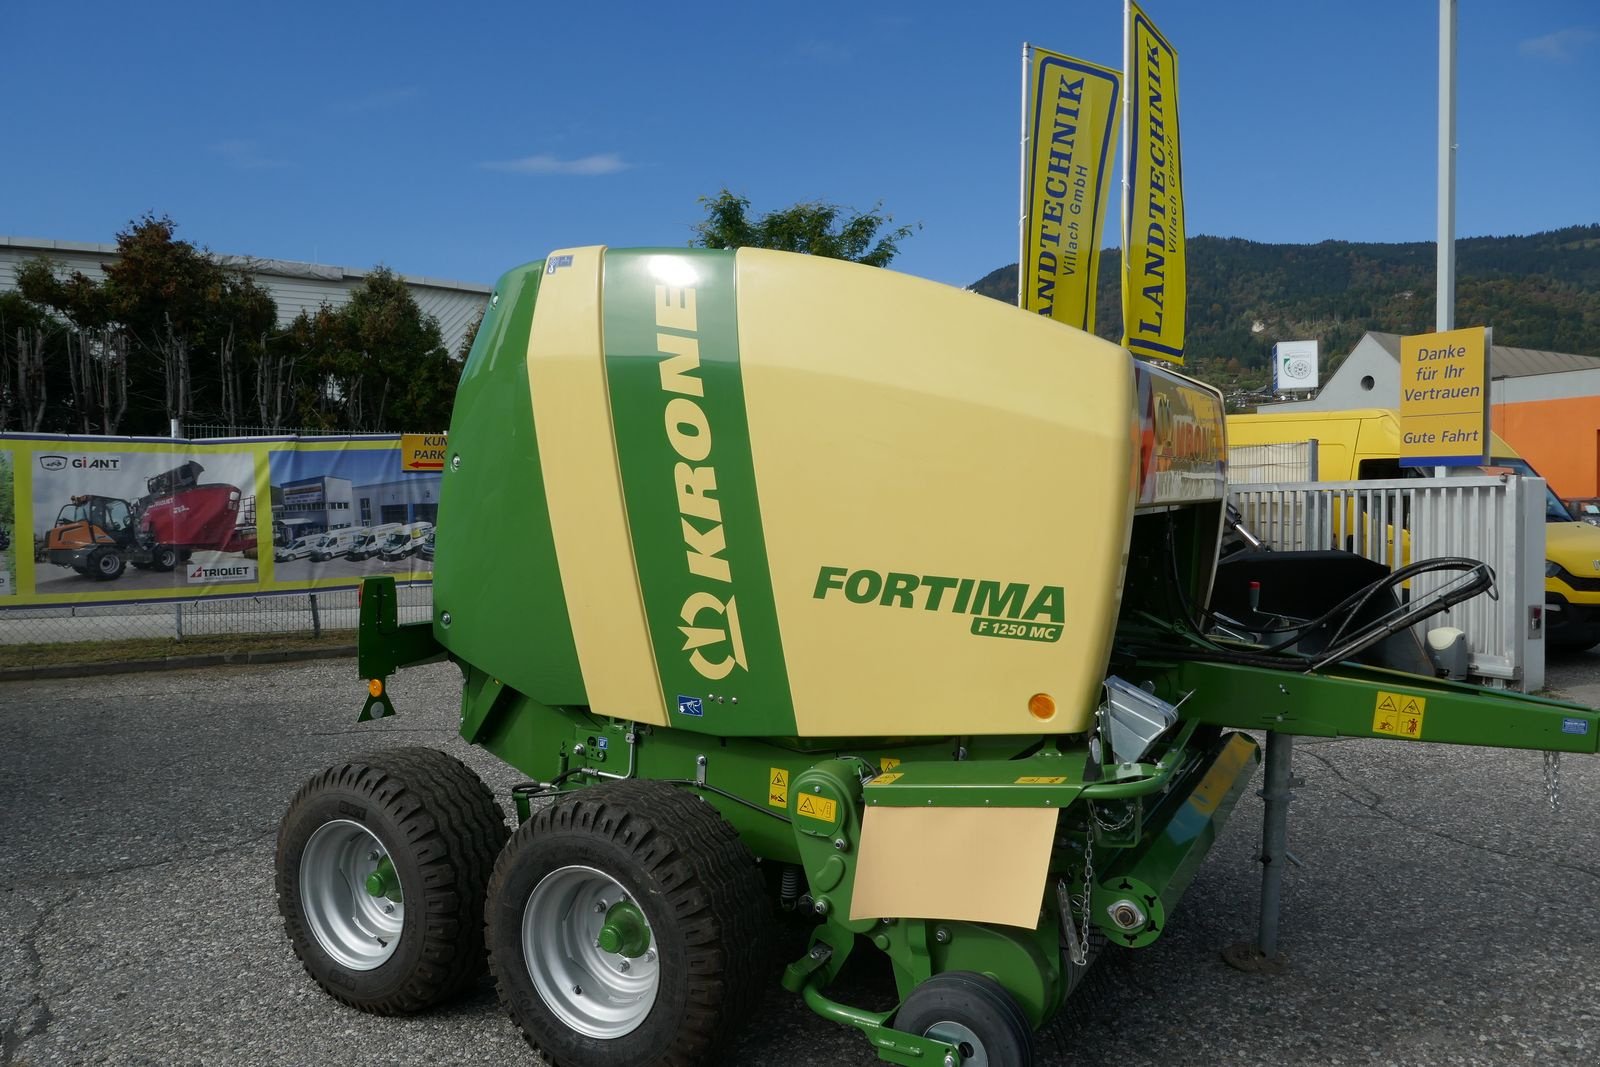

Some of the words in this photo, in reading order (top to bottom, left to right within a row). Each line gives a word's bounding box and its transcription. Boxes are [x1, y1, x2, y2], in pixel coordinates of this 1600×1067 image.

[1037, 74, 1085, 317] ANDTECHNIK
[1139, 37, 1166, 338] LANDTECHNIK
[1063, 221, 1079, 276] Villach
[1071, 165, 1089, 215] GmbH
[1168, 195, 1177, 254] Villach
[1417, 344, 1466, 362] Danke
[1416, 366, 1438, 381] für
[1444, 364, 1465, 379] Ihr
[1404, 386, 1480, 402] Vertrauen
[423, 436, 448, 447] KUN
[655, 284, 732, 583] KRONE
[1403, 432, 1436, 444] Gute
[1441, 429, 1479, 443] Fahrt
[414, 450, 446, 460] PARK
[202, 566, 249, 577] TRIOLIET
[813, 566, 1065, 624] FORTIMA
[978, 621, 989, 633] F
[992, 623, 1027, 637] 1250
[1029, 626, 1056, 640] MC
